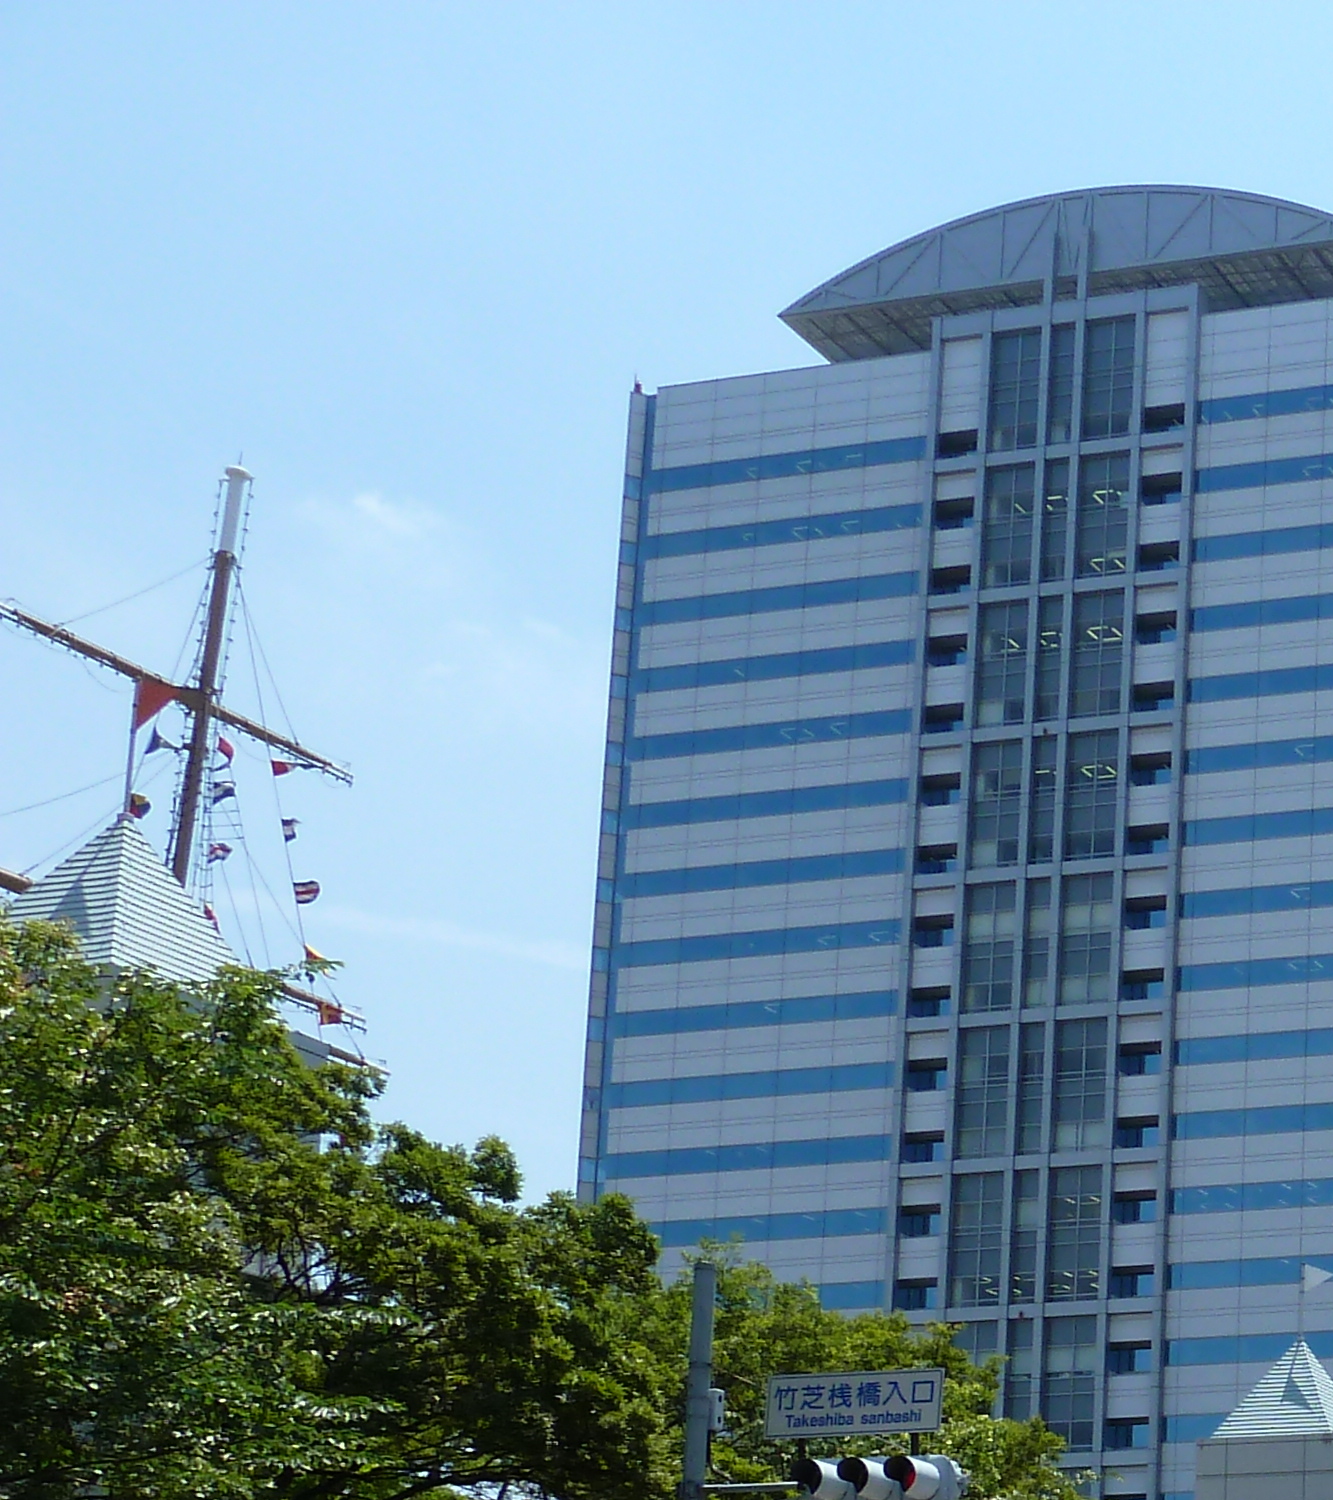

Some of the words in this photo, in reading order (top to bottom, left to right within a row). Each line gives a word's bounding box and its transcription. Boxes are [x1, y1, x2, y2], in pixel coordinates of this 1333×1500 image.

[773, 1380, 935, 1412] 竹芝桟橋入口
[785, 1412, 854, 1429] Takeshiba
[860, 1408, 922, 1425] sanbashi
